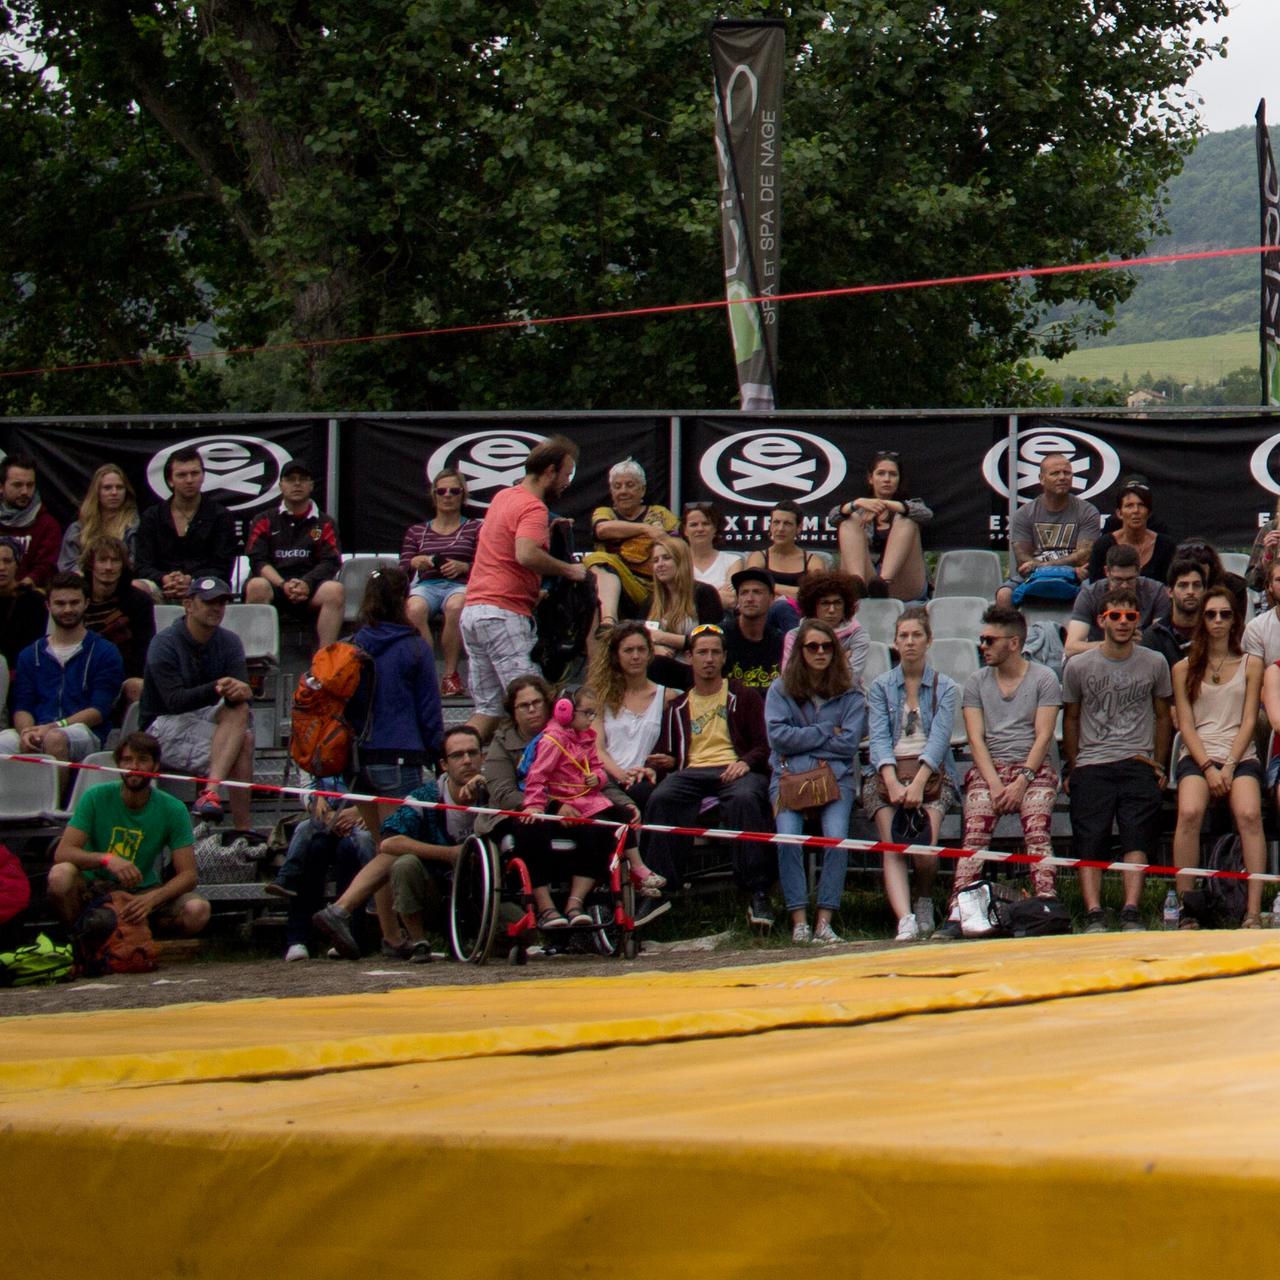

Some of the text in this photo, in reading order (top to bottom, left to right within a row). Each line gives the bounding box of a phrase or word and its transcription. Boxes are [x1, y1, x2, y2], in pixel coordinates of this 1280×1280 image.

[761, 110, 776, 325] SPA ET SPA DE NAGE
